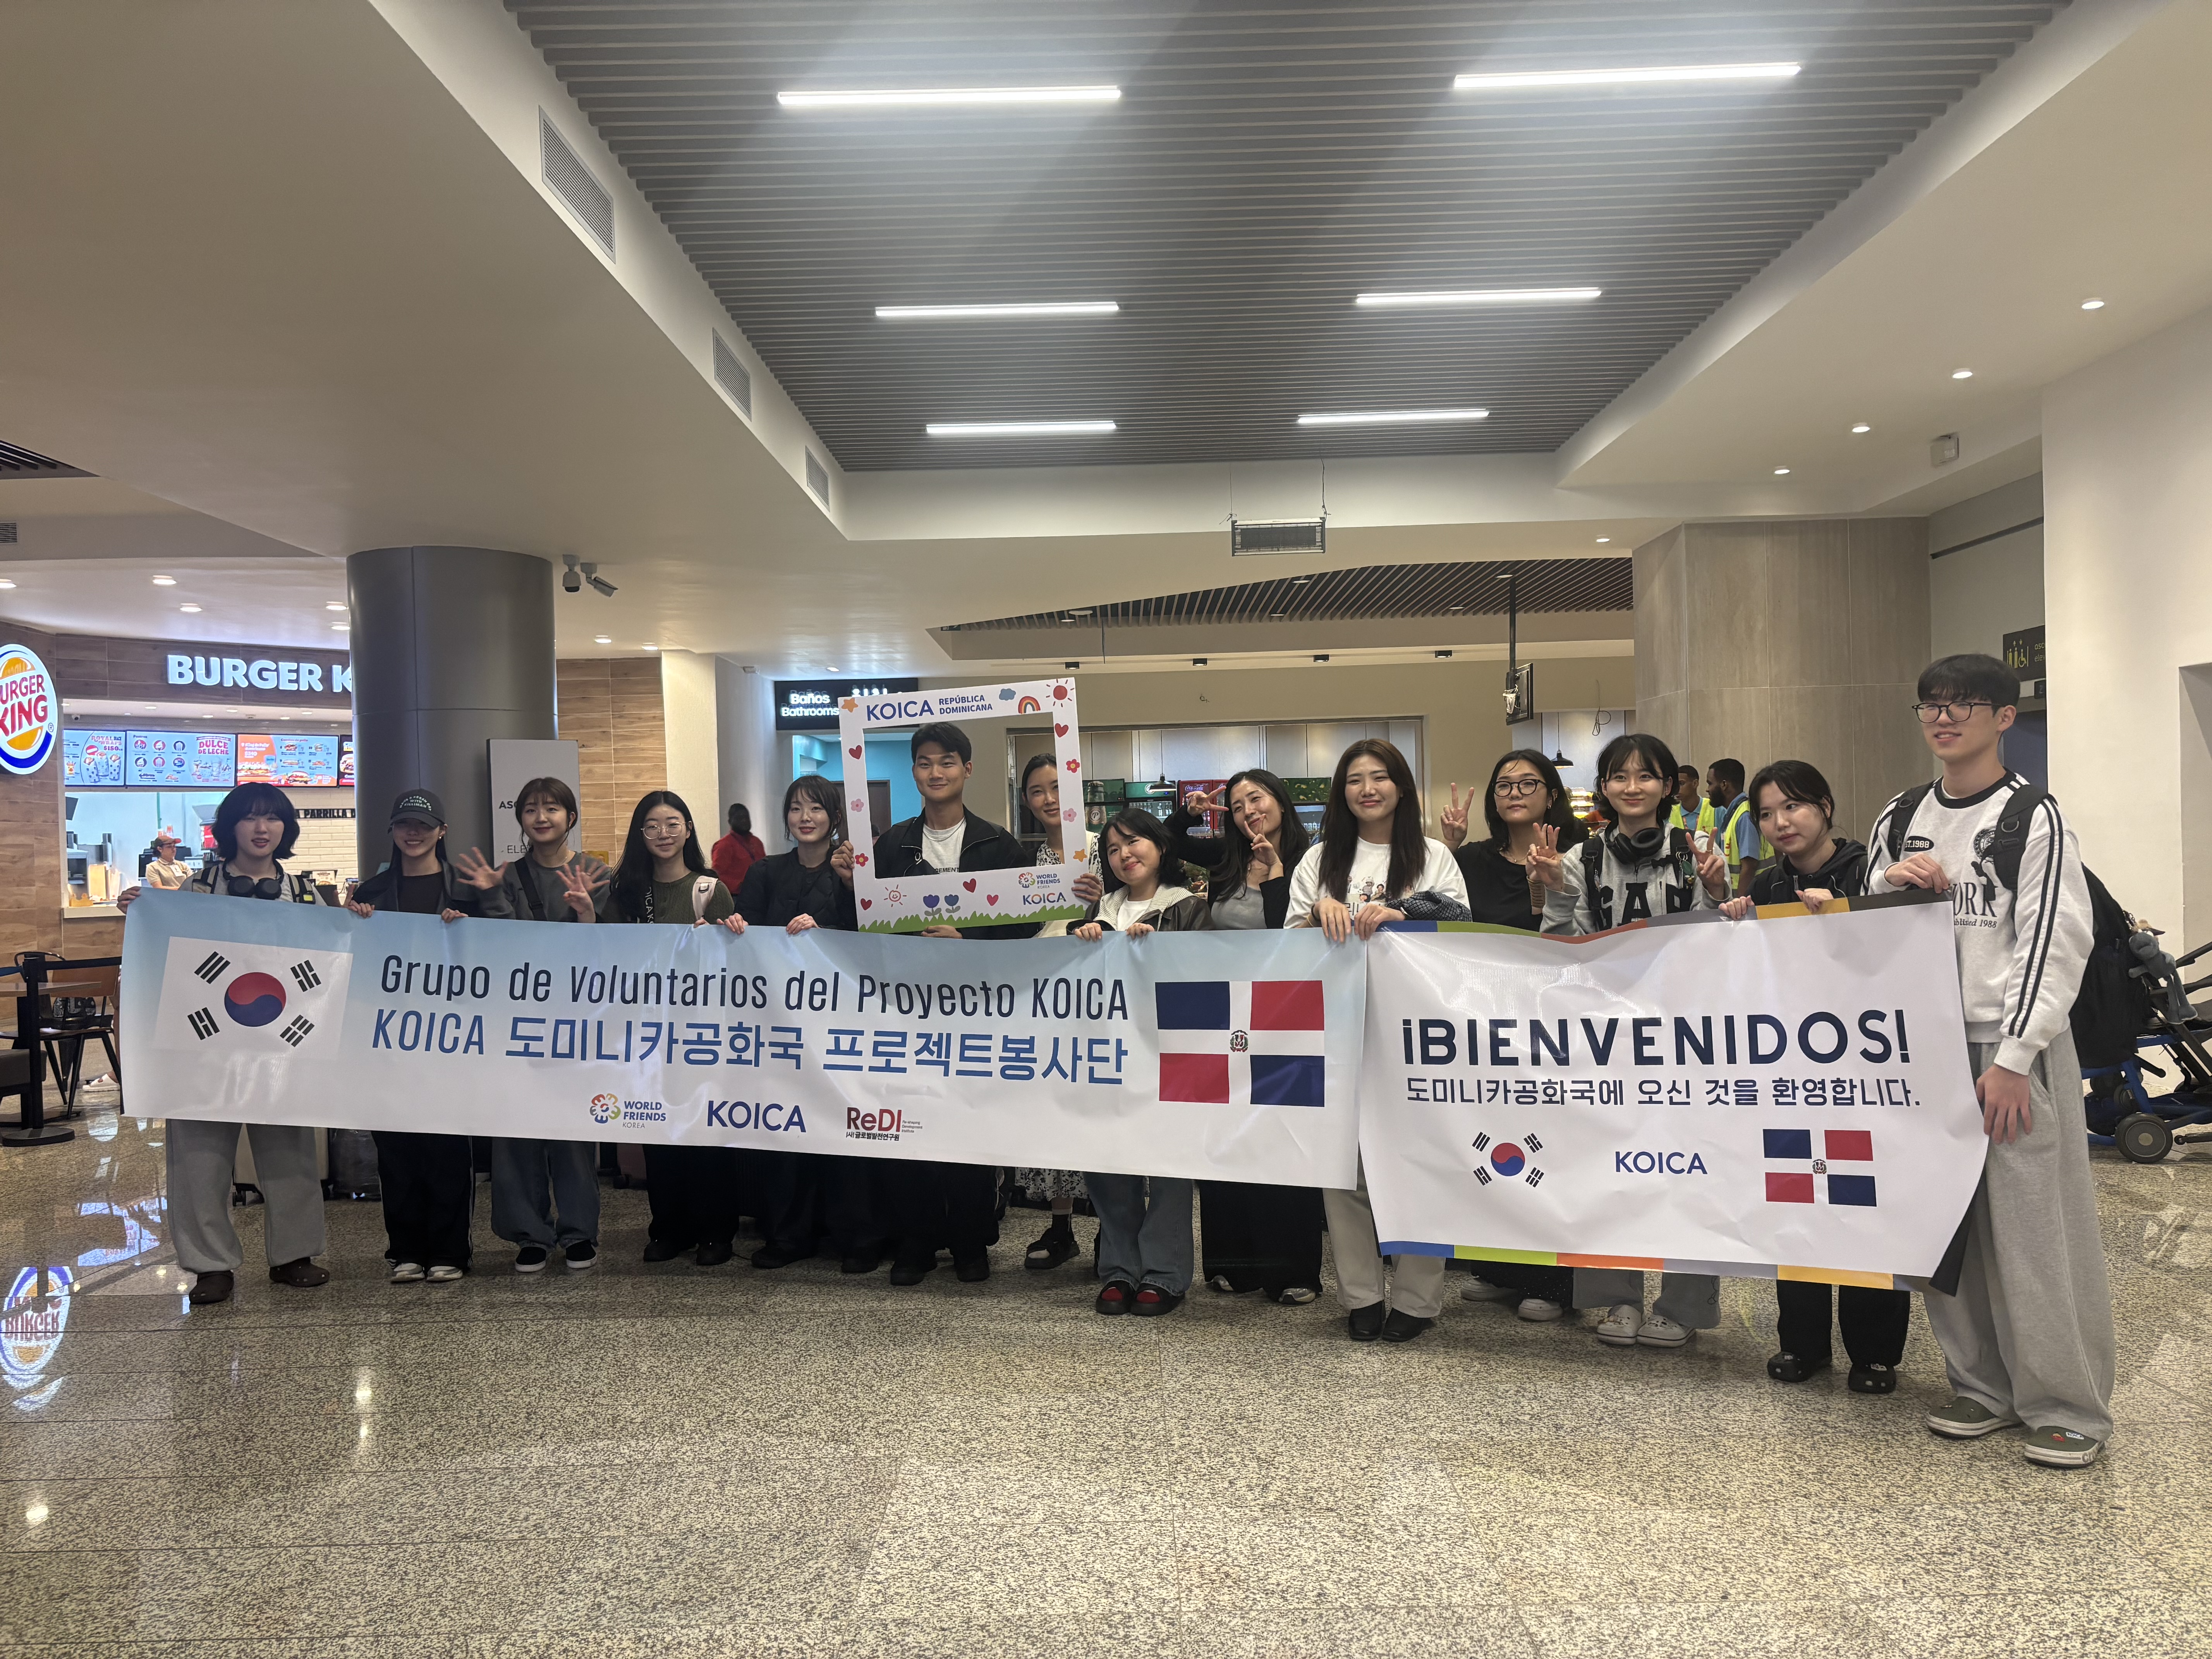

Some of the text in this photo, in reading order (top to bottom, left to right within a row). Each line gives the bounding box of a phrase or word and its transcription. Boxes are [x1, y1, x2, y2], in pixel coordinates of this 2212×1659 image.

[167, 654, 323, 692] BURGER
[790, 692, 830, 704] Baños
[939, 695, 985, 705] REPÚBLICA
[781, 707, 840, 716] Bathrooms
[866, 700, 934, 721] KOICA
[939, 704, 993, 714] DOMINICANA
[199, 740, 228, 749] DULCE
[304, 809, 347, 818] PARRILLA
[1023, 892, 1066, 905] KOICA
[1952, 882, 1997, 917] ORK
[1979, 919, 1997, 928] 1988
[381, 955, 1128, 1020] Grupo de Voluntarios del Proyecto KOICA
[1402, 1009, 1910, 1066] ¡BIENVENIDOS!
[372, 1009, 1128, 1085] KOICA 도미니카공화국 프로젝트봉사단
[1407, 1077, 1920, 1107] 도미니카공화국에 오신 것을 환영합니다.
[624, 1101, 662, 1111] WORLD
[623, 1111, 666, 1122] FRIENDS
[707, 1100, 806, 1133] KOICA
[847, 1107, 902, 1132] ReDI
[1615, 1151, 1708, 1175] KOICA
